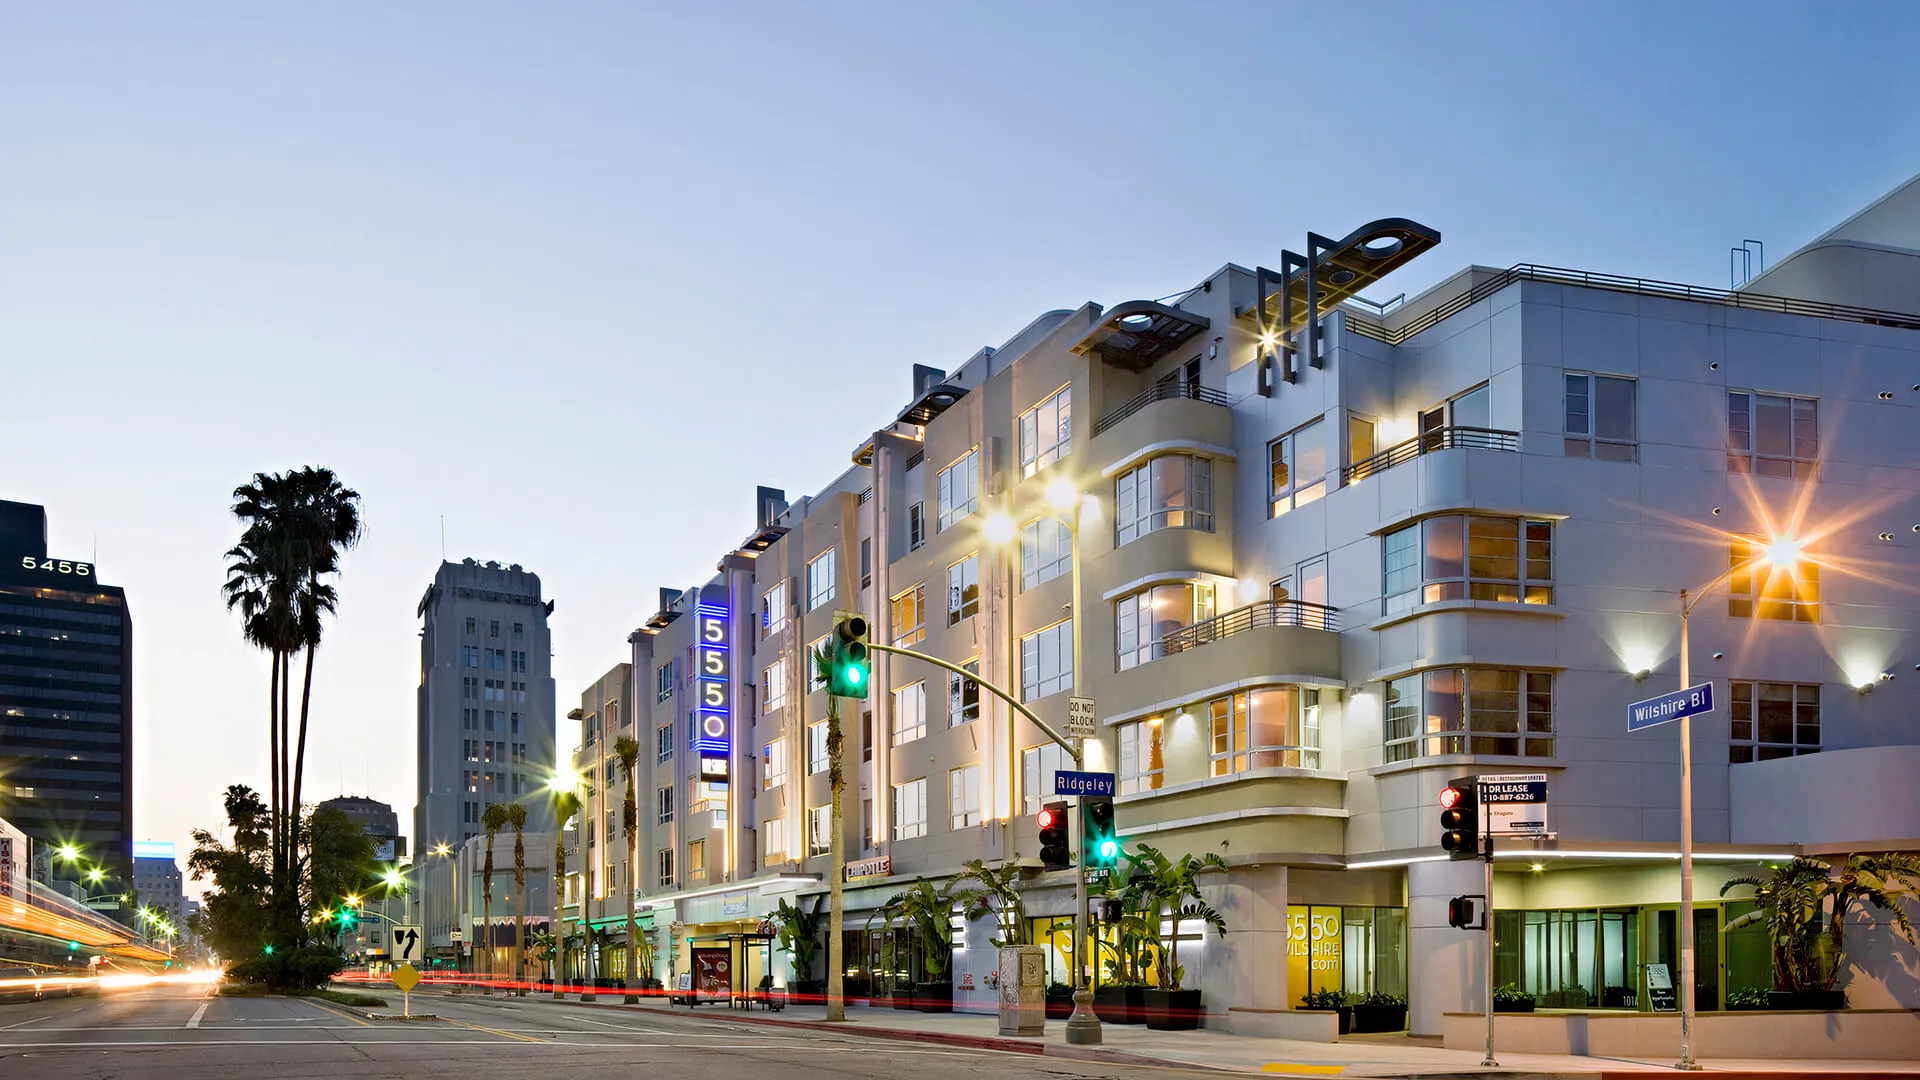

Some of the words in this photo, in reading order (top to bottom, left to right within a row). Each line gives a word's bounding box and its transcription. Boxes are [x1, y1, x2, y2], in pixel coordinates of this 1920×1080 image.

[22, 556, 90, 576] 5455
[704, 618, 725, 738] 5550
[1070, 702, 1080, 712] DO
[1081, 703, 1095, 713] NOT
[1635, 699, 1686, 721] Wilshire
[1070, 715, 1095, 726] BLOCK
[1057, 776, 1112, 794] Ridgeley
[1502, 785, 1528, 793] LEASE
[1287, 942, 1340, 956] ILSHIRE
